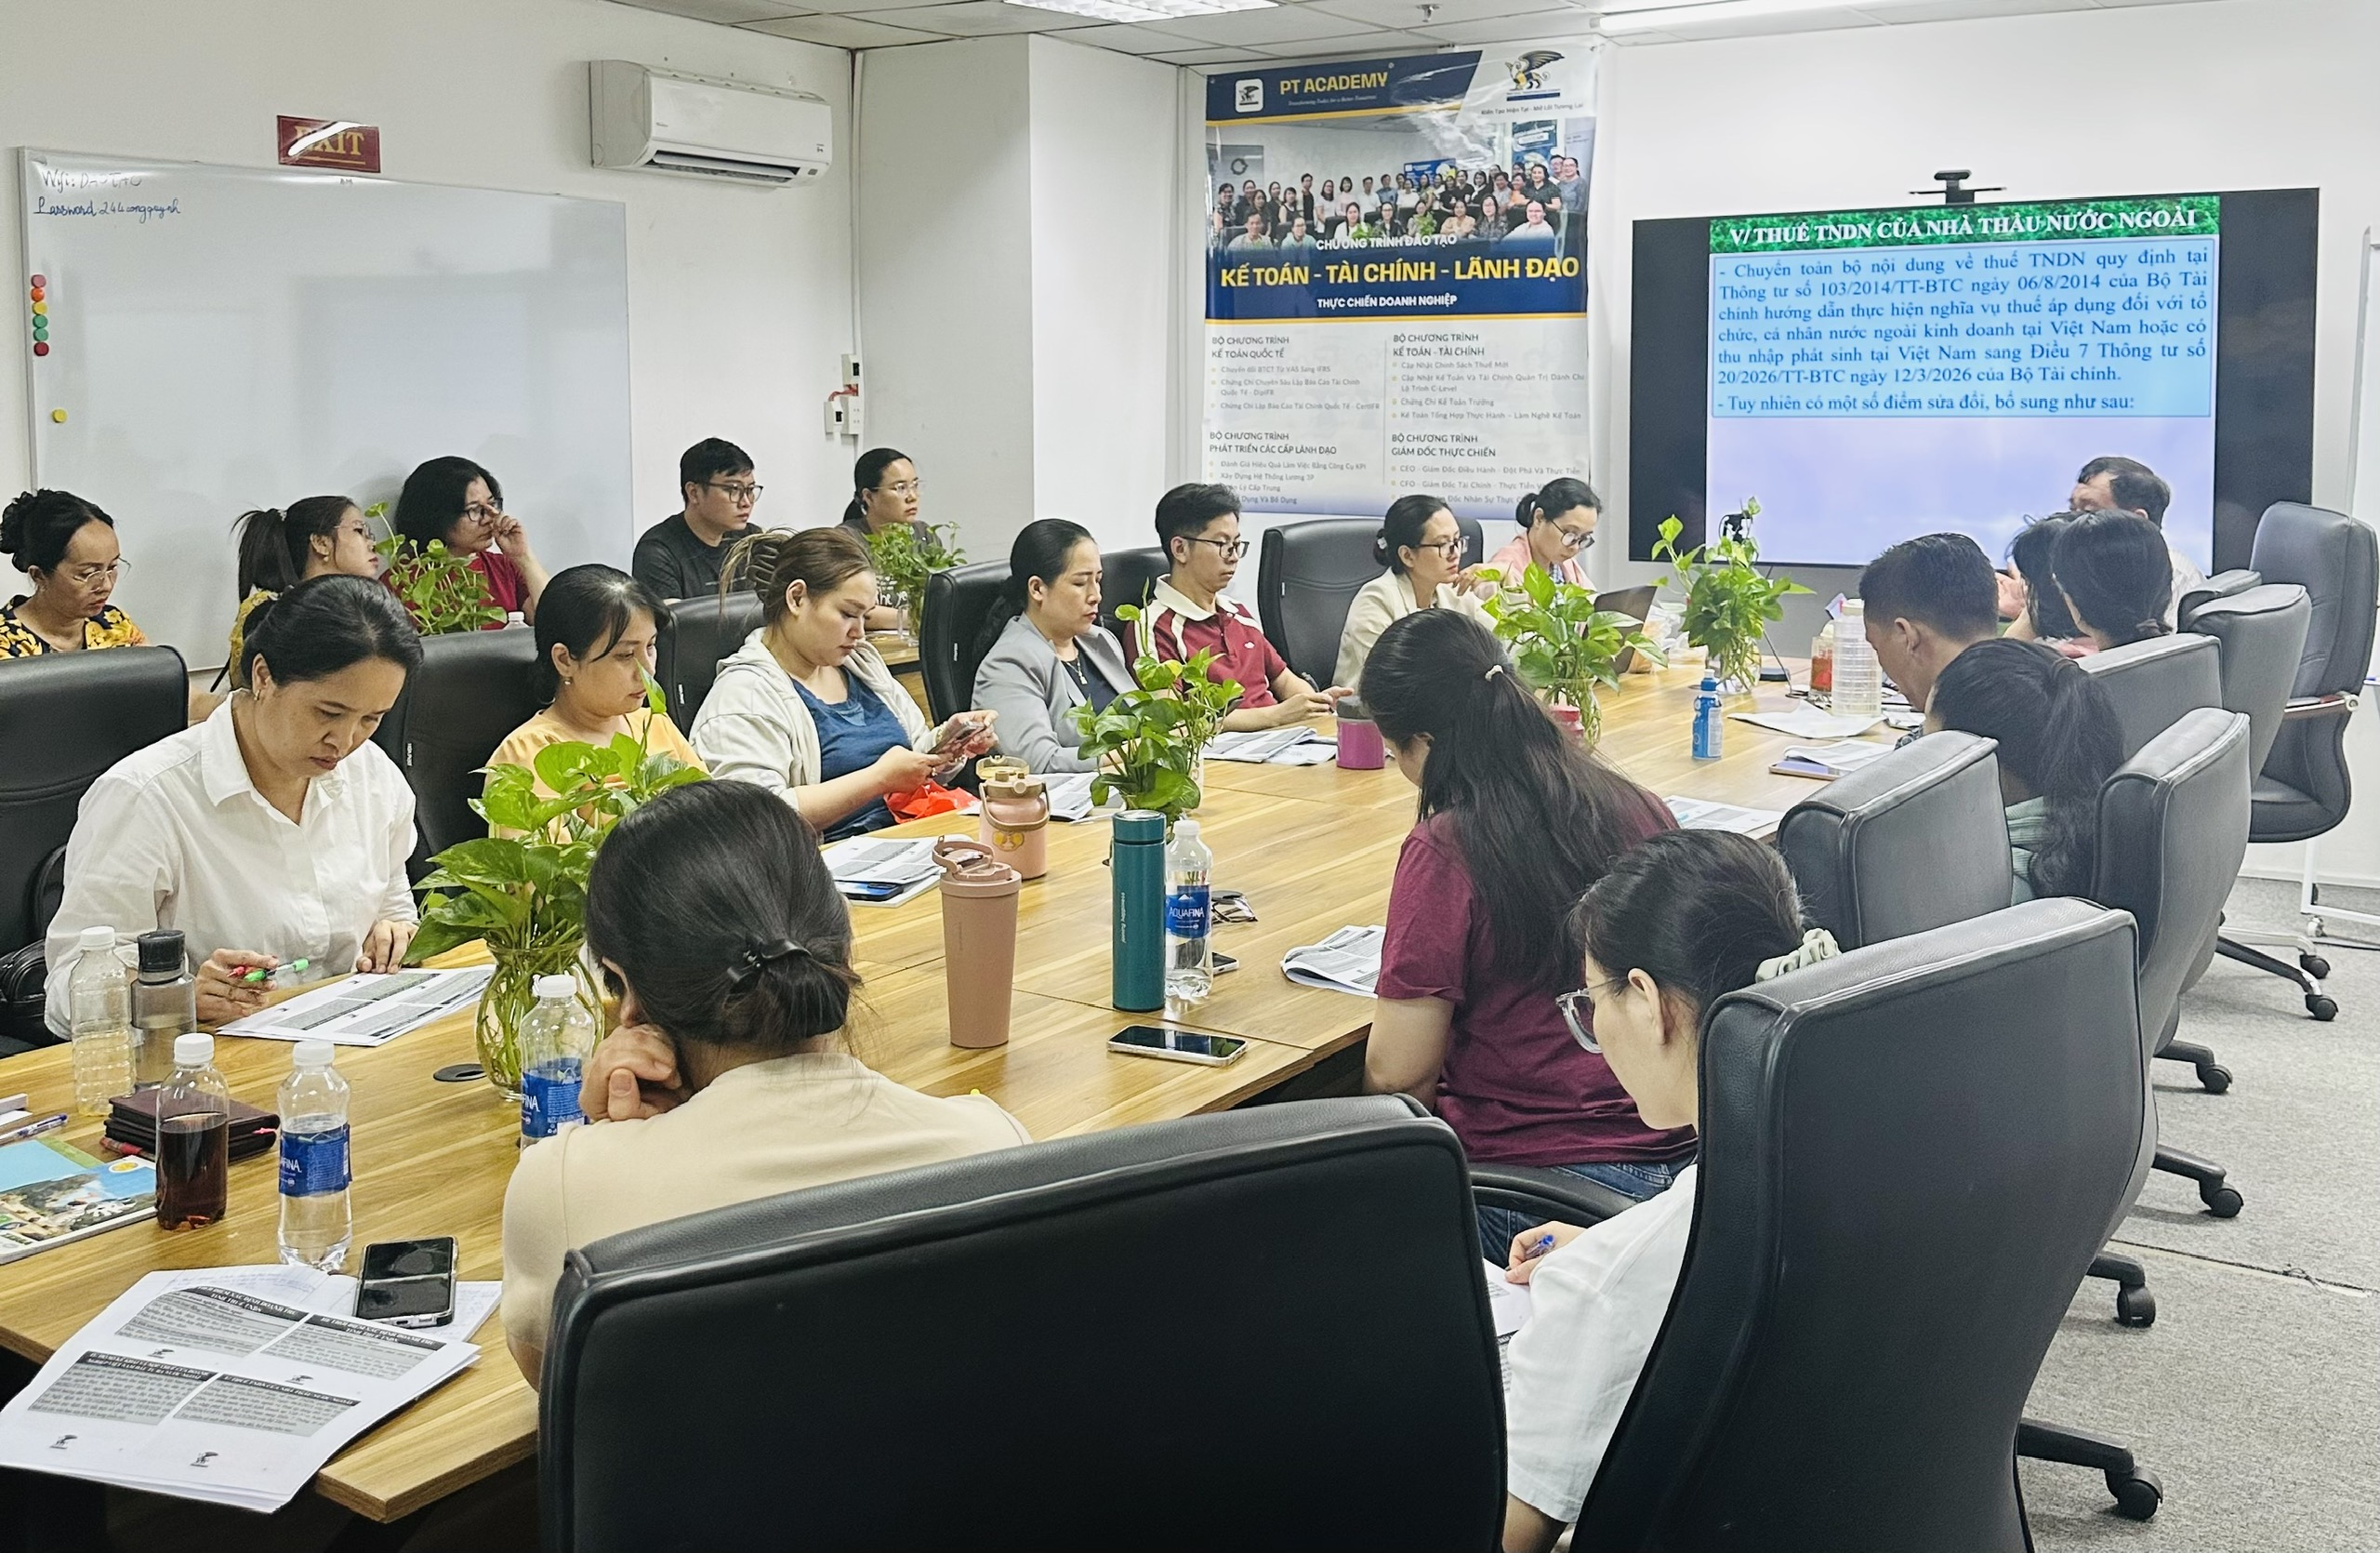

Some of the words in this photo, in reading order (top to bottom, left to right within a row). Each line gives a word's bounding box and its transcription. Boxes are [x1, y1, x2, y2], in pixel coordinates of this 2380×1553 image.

[1280, 80, 1301, 95] PT
[1303, 72, 1388, 93] ACADEMY
[1731, 227, 1752, 246] V/
[1753, 222, 1809, 244] THUẾ
[1814, 222, 1871, 241] TNDN
[1877, 217, 1922, 239] CỦA
[1926, 214, 1974, 235] NHÀ
[1977, 212, 2040, 233] THẦU
[2046, 209, 2114, 232] NƯỚC
[2120, 206, 2196, 229] NGOÀI
[1316, 238, 1368, 251] CHƯƠNG
[1370, 236, 1402, 248] TRÌNH
[1405, 234, 1431, 246] ĐÀO
[1434, 235, 1457, 247] TẠO
[1221, 262, 1250, 286] KẾ
[1253, 262, 1309, 285] TOÁN
[1326, 260, 1358, 283] TÀI
[1364, 258, 1435, 283] CHÍNH
[1454, 256, 1520, 279] LÃNH
[1525, 257, 1580, 282] ĐẠO
[1734, 259, 1791, 280] Chuyển
[1800, 261, 1831, 276] toàn
[1843, 259, 1861, 275] bộ
[1871, 259, 1895, 274] nội
[1905, 257, 1945, 274] dung
[1955, 252, 1973, 270] về
[1984, 250, 2018, 269] thuế
[2029, 251, 2084, 268] TNDN
[2096, 254, 2127, 270] quy
[2137, 248, 2175, 267] định
[2187, 246, 2207, 265] tại
[1720, 285, 1766, 302] Thông
[1774, 286, 1791, 298] tư
[1795, 280, 1811, 297] số
[1821, 278, 1963, 297] 103/2014/TT-BTC
[1971, 277, 2009, 295] ngày
[2017, 273, 2100, 290] 06/8/2014
[2109, 274, 2138, 288] của
[2147, 272, 2171, 289] Bộ
[2179, 271, 2207, 286] Tài
[1317, 299, 1345, 310] THỰC
[1347, 295, 1378, 307] CHIẾN
[1379, 297, 1417, 307] DOANH
[1419, 293, 1457, 307] NGHIỆP
[1718, 306, 1758, 320] chính
[1765, 306, 1811, 322] hướng
[1817, 300, 1844, 318] dẫn
[1851, 303, 1884, 319] thực
[1891, 301, 1924, 318] hiện
[1930, 300, 1974, 319] nghĩa
[1980, 303, 2001, 315] vụ
[2007, 294, 2042, 313] thuế
[2048, 299, 2068, 316] áp
[2073, 297, 2116, 315] dụng
[2122, 293, 2149, 311] đối
[2156, 295, 2183, 310] với
[2190, 291, 2207, 310] tổ
[1394, 334, 1406, 343] BỘ
[1408, 334, 1448, 342] CHƯƠNG
[1451, 332, 1478, 341] TRÌNH
[1718, 327, 1757, 341] chức,
[1764, 329, 1779, 340] cá
[1787, 326, 1822, 340] nhân
[1829, 325, 1866, 339] nước
[1874, 324, 1916, 342] ngoài
[1924, 323, 1958, 338] kinh
[1965, 322, 2015, 337] doanh
[2022, 321, 2042, 338] tại
[2050, 320, 2083, 338] Việt
[2092, 320, 2131, 335] Nam
[2139, 319, 2178, 336] hoặc
[2186, 318, 2206, 333] có
[1212, 337, 1224, 346] BỘ
[1227, 337, 1263, 345] CHƯƠNG
[1265, 336, 1289, 344] TRÌNH
[1394, 346, 1404, 356] KẾ
[1407, 346, 1431, 356] TOÁN
[1439, 346, 1452, 356] TÀI
[1455, 345, 1484, 356] CHÍNH
[1212, 348, 1223, 357] KẾ
[1225, 349, 1248, 357] TOÁN
[1250, 348, 1273, 359] QUỐC
[1276, 347, 1284, 357] TẾ
[1718, 350, 1740, 363] thu
[1748, 348, 1784, 366] nhập
[1791, 347, 1823, 366] phát
[1831, 346, 1862, 362] sinh
[1871, 347, 1889, 363] tại
[1898, 345, 1930, 363] Việt
[1938, 345, 1976, 360] Nam
[1984, 348, 2021, 363] sang
[2030, 339, 2069, 359] Điều
[2079, 343, 2088, 357] 7
[2097, 342, 2151, 362] Thông
[2161, 344, 2178, 357] tư
[2187, 338, 2206, 357] số
[1718, 369, 1846, 384] 20/2026/TT-BTC
[1850, 371, 1887, 386] ngày
[1895, 367, 1972, 382] 12/3/2026
[1977, 368, 2004, 381] của
[2010, 366, 2033, 383] Bộ
[2038, 365, 2065, 380] Tài
[2070, 365, 2122, 380] chính.
[1728, 395, 1756, 413] Tuy
[1761, 395, 1800, 410] nhiên
[1805, 397, 1823, 409] có
[1828, 394, 1857, 411] một
[1861, 392, 1879, 409] số
[1884, 390, 1922, 409] điểm
[1927, 395, 1954, 409] sửa
[1959, 391, 1990, 410] đổi,
[1995, 391, 2015, 409] bổ
[2020, 398, 2058, 413] sung
[2064, 393, 2096, 409] như
[2101, 396, 2134, 409] sau:
[1210, 432, 1223, 441] BỘ
[1392, 434, 1404, 444] BỘ
[1407, 434, 1448, 443] CHƯƠNG
[1450, 434, 1477, 443] TRÌNH
[1392, 447, 1414, 456] GIÁM
[1417, 447, 1436, 456] ĐỐC
[1439, 448, 1464, 457] THỰC
[1467, 447, 1496, 457] CHIẾN
[1169, 906, 1205, 920] AQUAFINA
